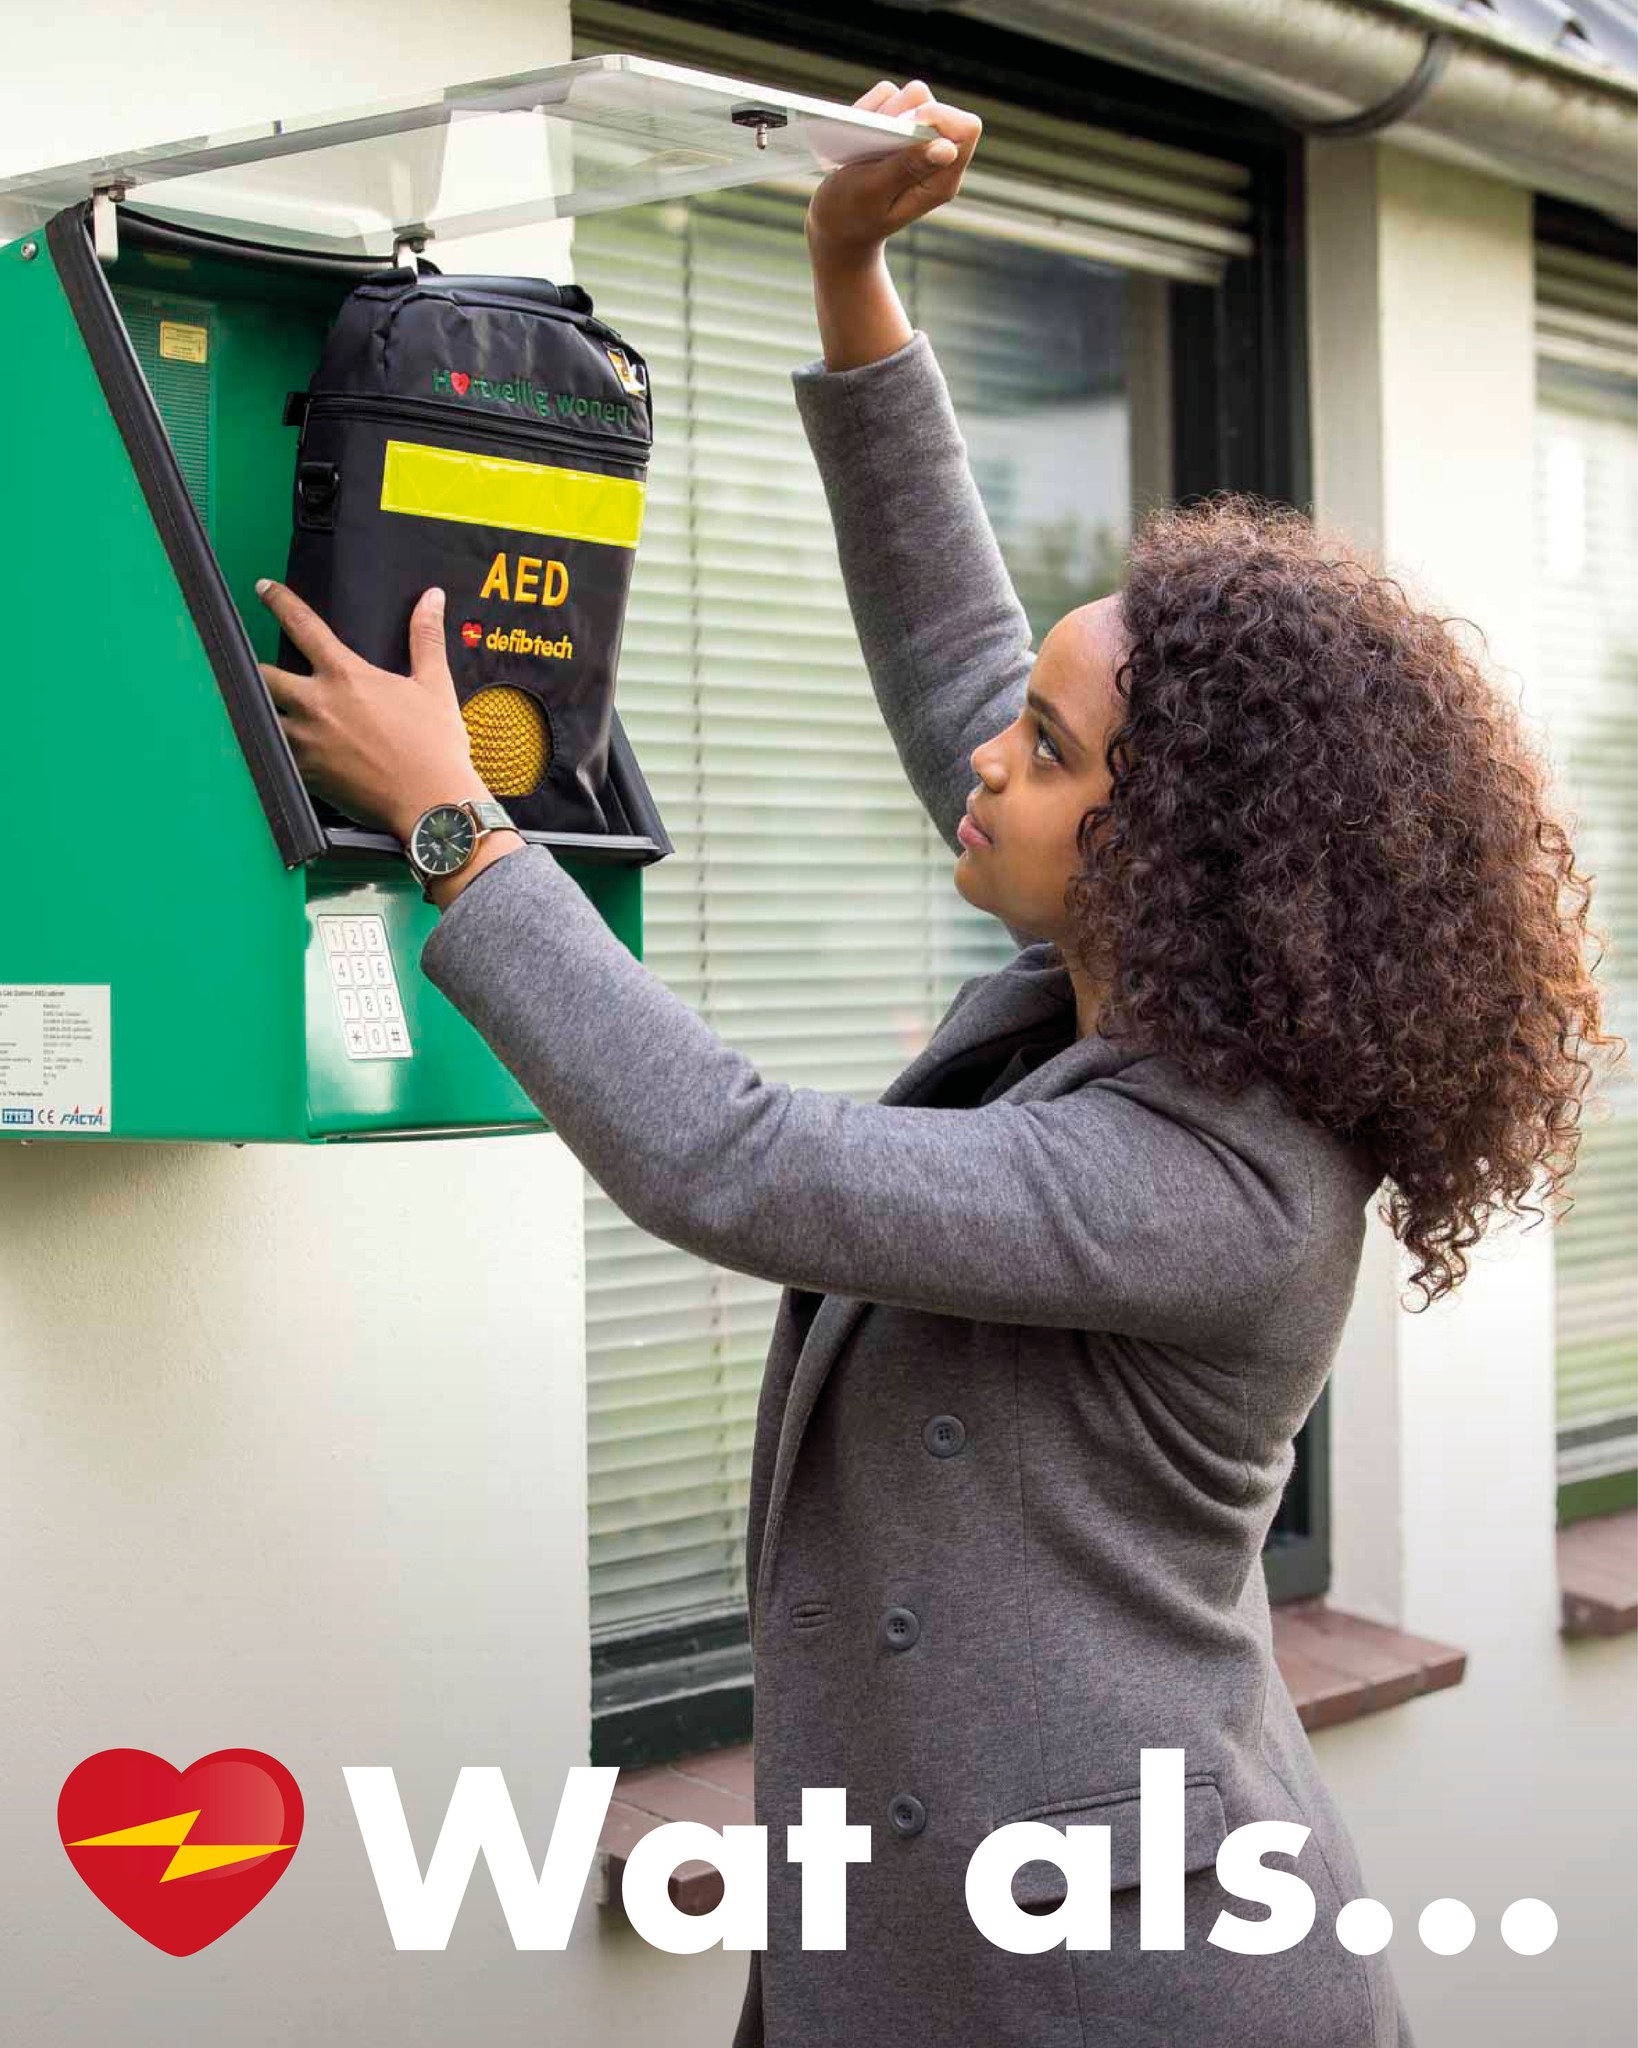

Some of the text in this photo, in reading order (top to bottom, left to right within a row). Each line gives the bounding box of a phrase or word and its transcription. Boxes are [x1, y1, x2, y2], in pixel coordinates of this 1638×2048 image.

[480, 552, 569, 607] AED
[486, 628, 573, 659] defibtech
[349, 929, 358, 946] 2
[369, 927, 378, 946] 3
[338, 962, 385, 979] 4 5 6
[344, 994, 393, 1013] 7 8 9
